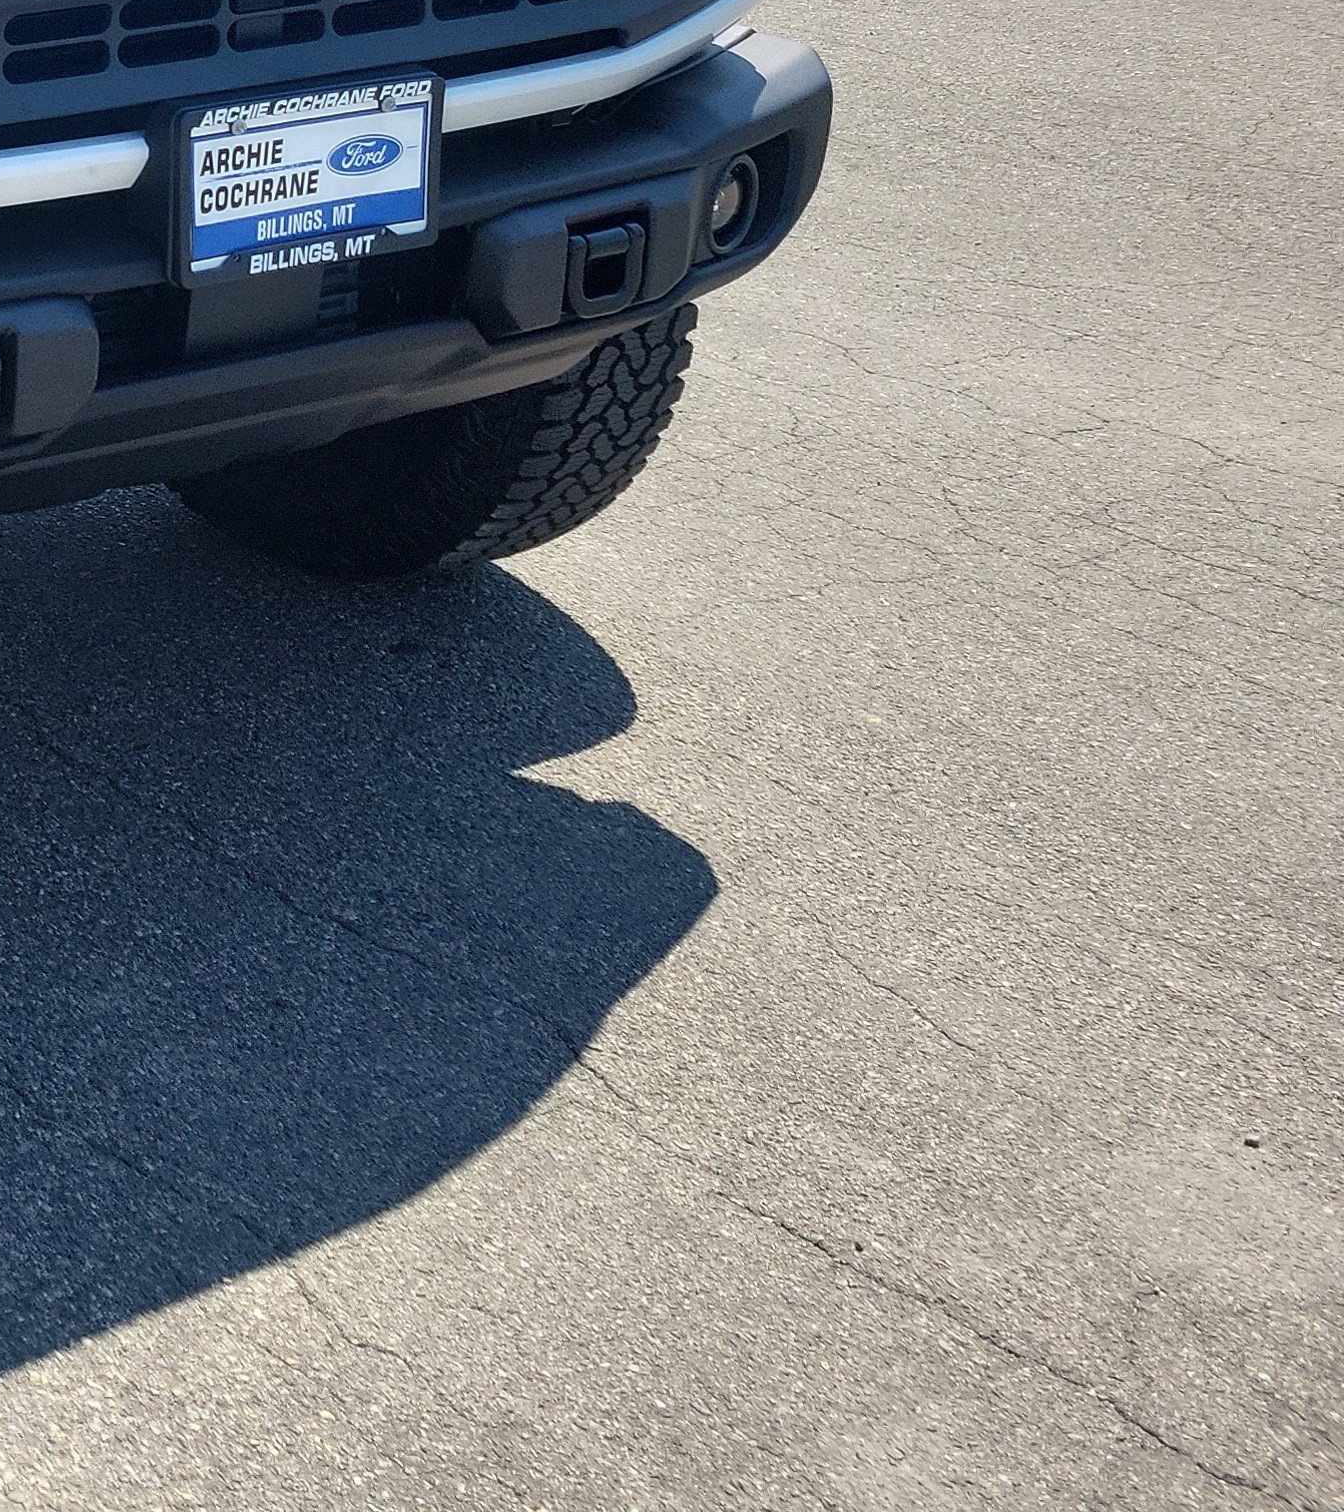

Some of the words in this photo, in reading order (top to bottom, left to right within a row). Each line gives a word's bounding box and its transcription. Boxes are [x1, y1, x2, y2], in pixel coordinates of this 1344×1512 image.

[199, 101, 271, 128] ARCHIE
[272, 86, 378, 116] COCHRANE
[379, 79, 432, 101] FORD
[199, 138, 284, 177] ARCHIE
[341, 140, 387, 169] Ford
[200, 168, 320, 214] COCHRANE
[257, 208, 327, 241] BILLINGS,
[332, 203, 356, 227] MT
[249, 241, 339, 275] BILLINGS,
[345, 234, 376, 258] MT
